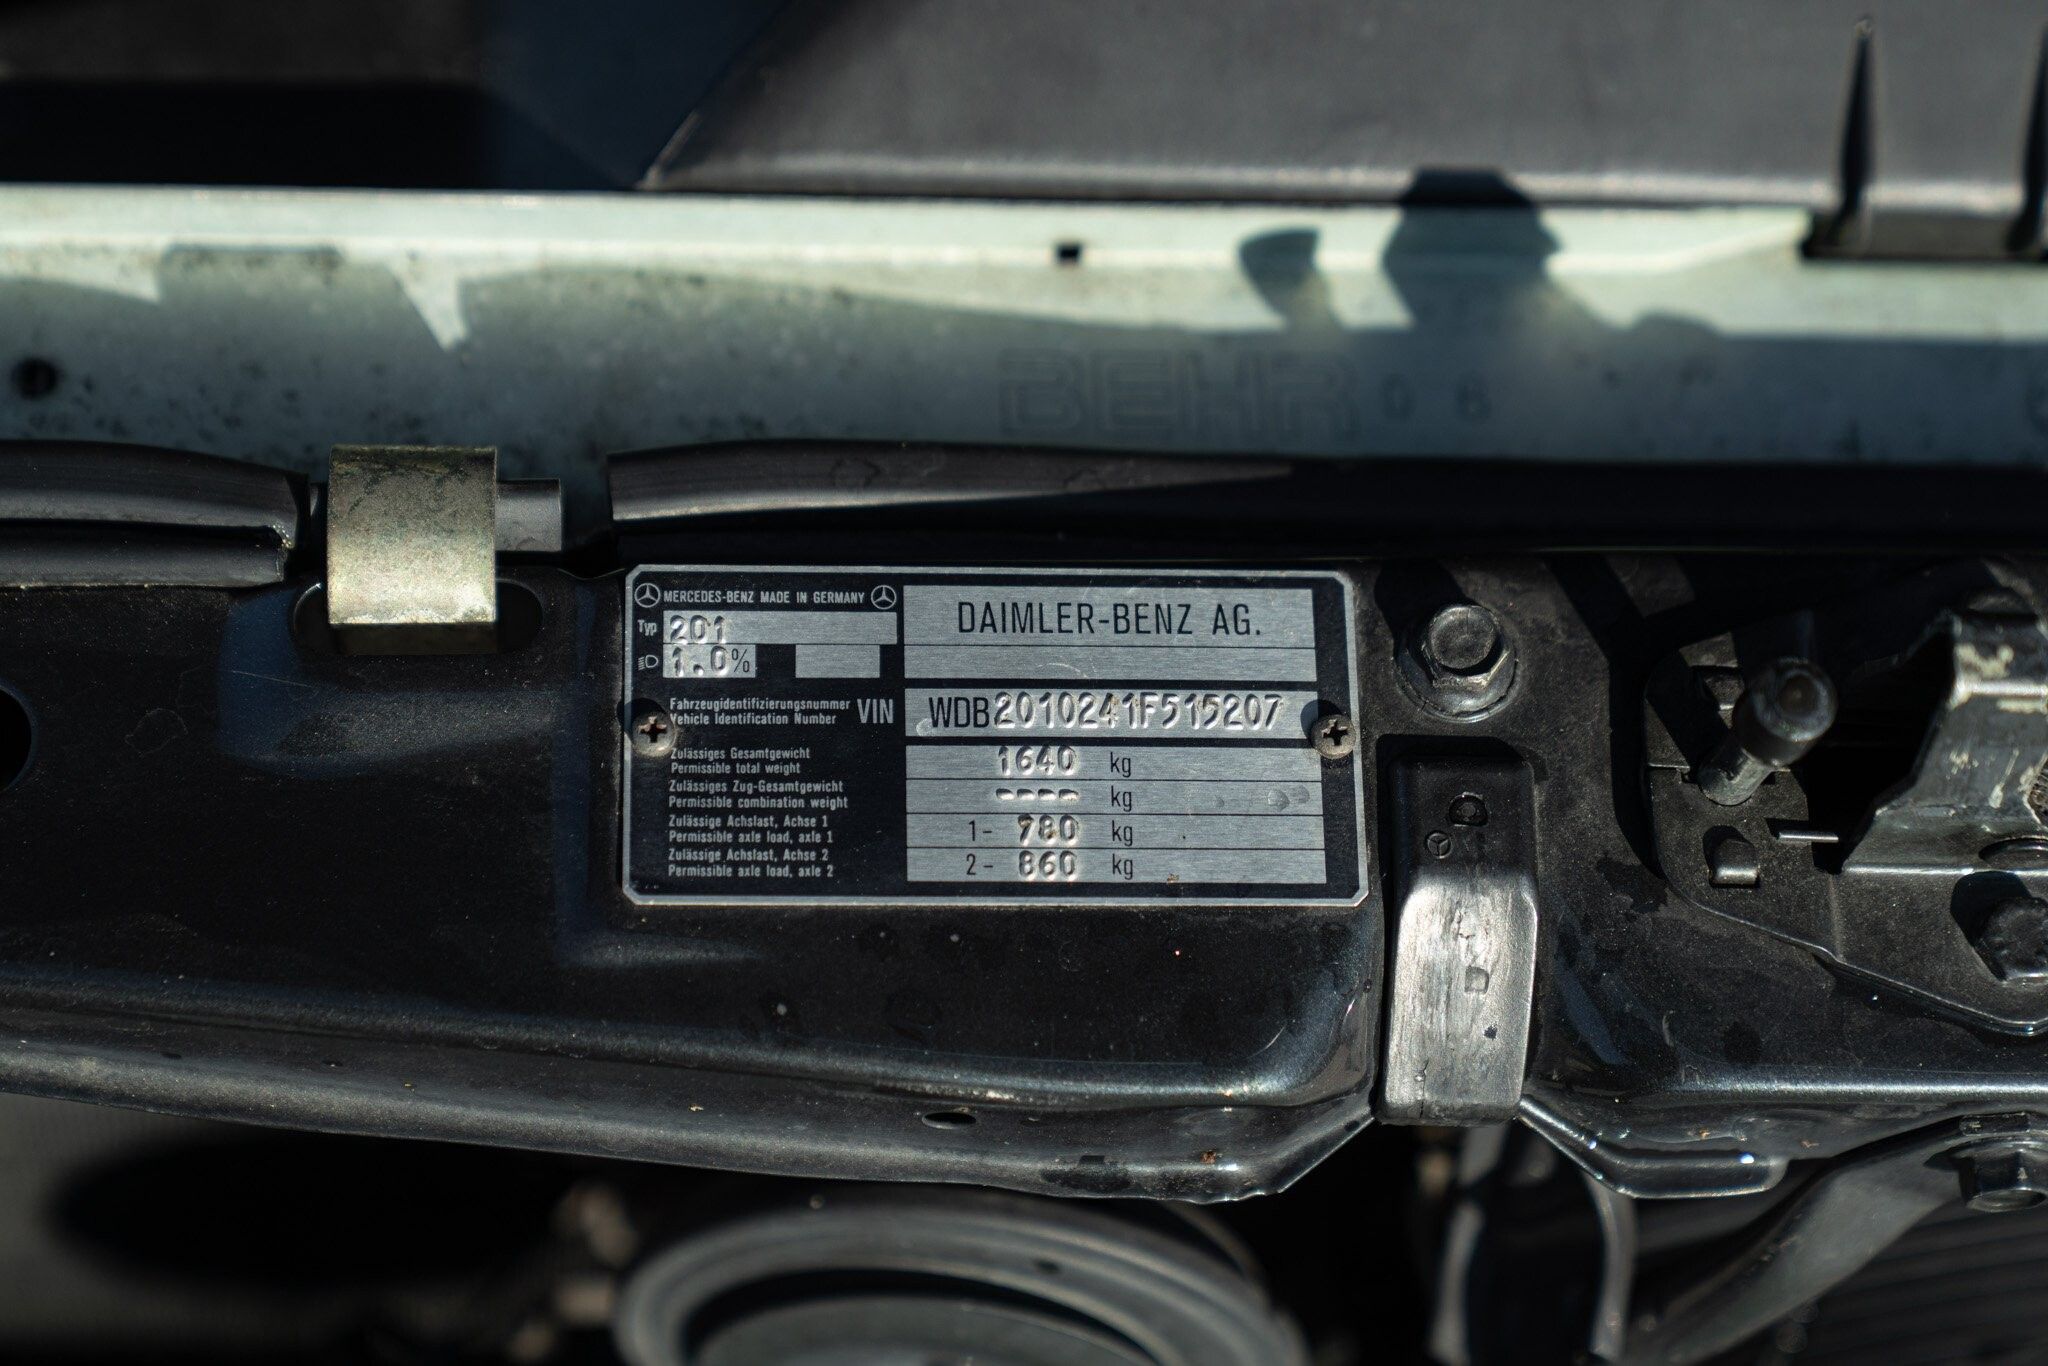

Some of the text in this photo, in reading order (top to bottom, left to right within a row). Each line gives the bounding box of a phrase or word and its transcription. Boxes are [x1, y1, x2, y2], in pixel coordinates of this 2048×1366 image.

[997, 346, 1361, 442] BEHR
[664, 591, 864, 604] MERCEDES-BENZ MADE IN GERMANY
[957, 601, 1261, 635] DAIMLER-BENZ AG.
[638, 615, 727, 644] Typ 201
[670, 698, 850, 712] Fahrzeugidentifizierungsnummer
[857, 699, 894, 723] VIN
[670, 713, 836, 725] Vehicle Identification Number
[671, 747, 810, 761] Zulässiges Gesamtgewicht
[998, 745, 1131, 776] 1640 kg
[672, 763, 801, 776] Permissible total weight
[669, 780, 843, 794] Zulässiges Zug-Gesamtgewicht
[669, 796, 848, 810] Permissible combination weight
[1111, 786, 1133, 811] kg
[669, 815, 828, 829] Zulässige Achslast, Achse 1
[1017, 814, 1077, 844] 780
[1112, 821, 1134, 846] kg
[669, 831, 833, 844] Permissible axle load, axle 1
[669, 848, 829, 863] Zulässige Achslast, Achse 2
[668, 865, 833, 878] Permissible axle load, axle 2
[1018, 850, 1077, 877] 860
[1112, 854, 1134, 879] kg
